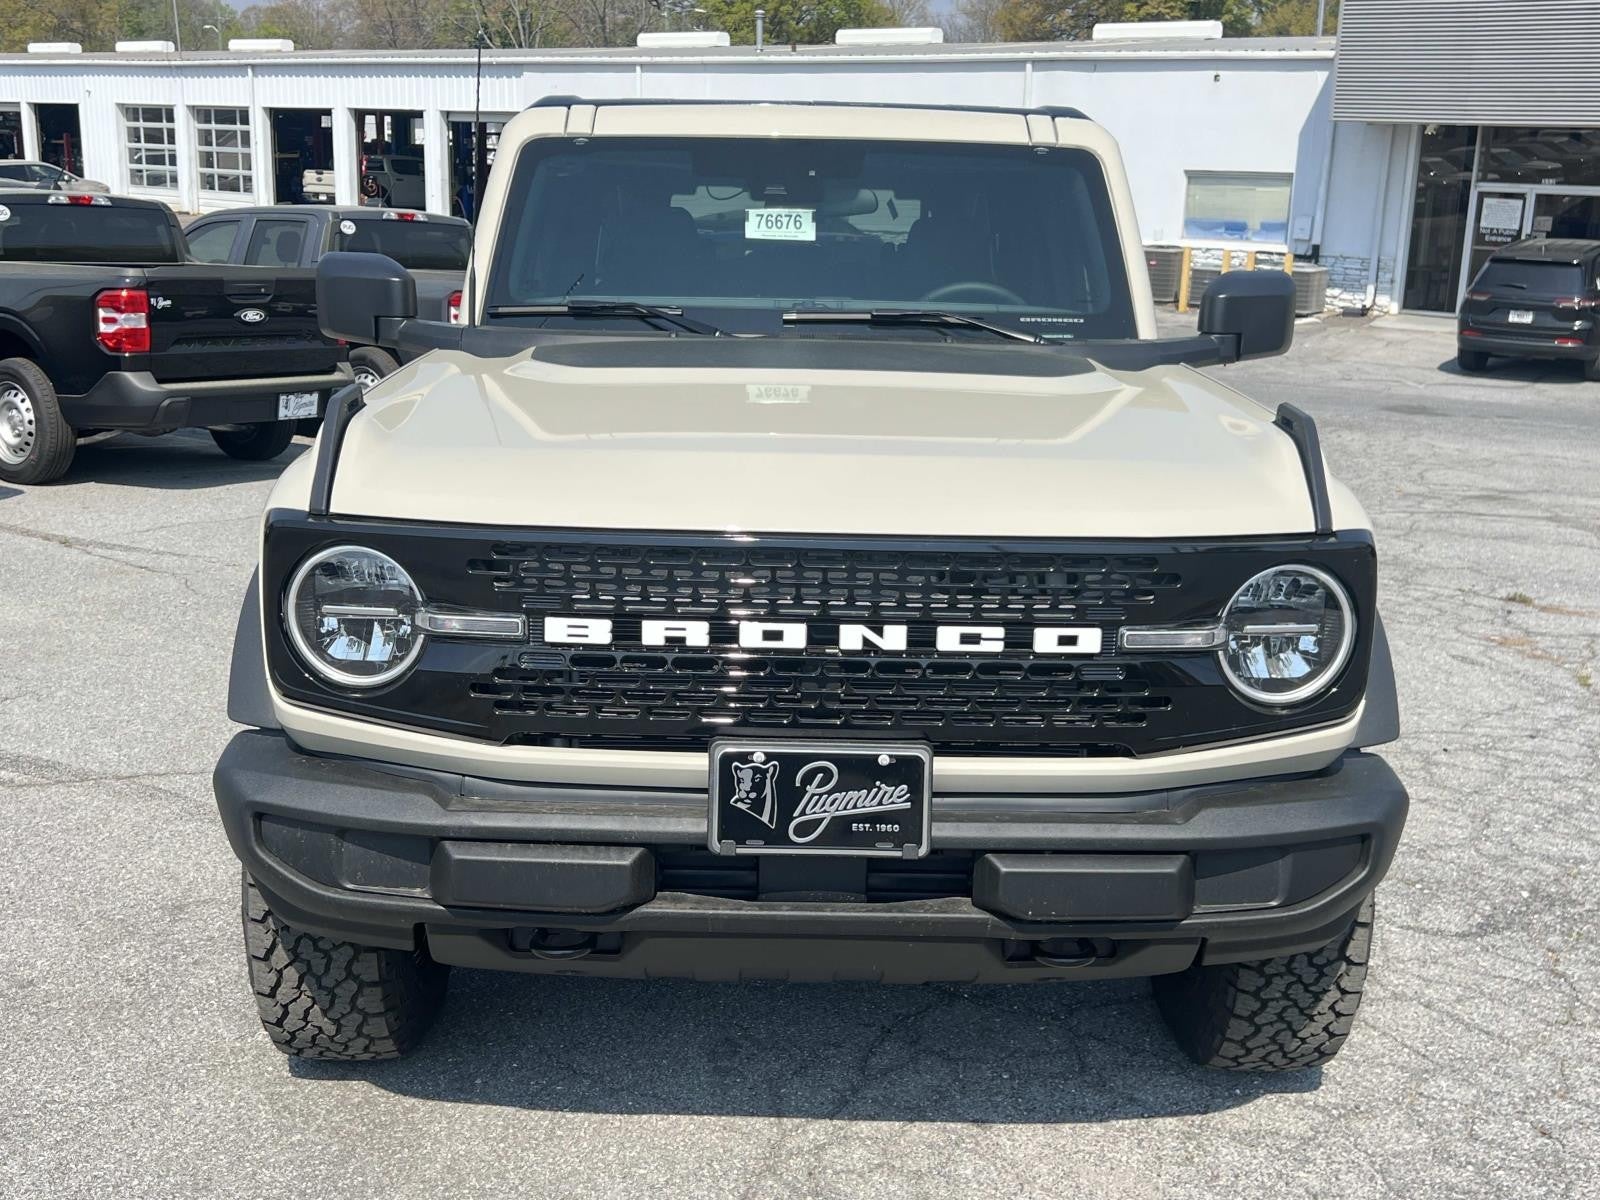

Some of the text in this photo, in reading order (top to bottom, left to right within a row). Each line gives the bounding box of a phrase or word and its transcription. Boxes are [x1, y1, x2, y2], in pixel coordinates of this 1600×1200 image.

[755, 213, 803, 230] 76676
[544, 617, 1102, 653] BRONCO
[788, 761, 911, 843] Pugmire
[851, 823, 900, 833] EST. 1960
